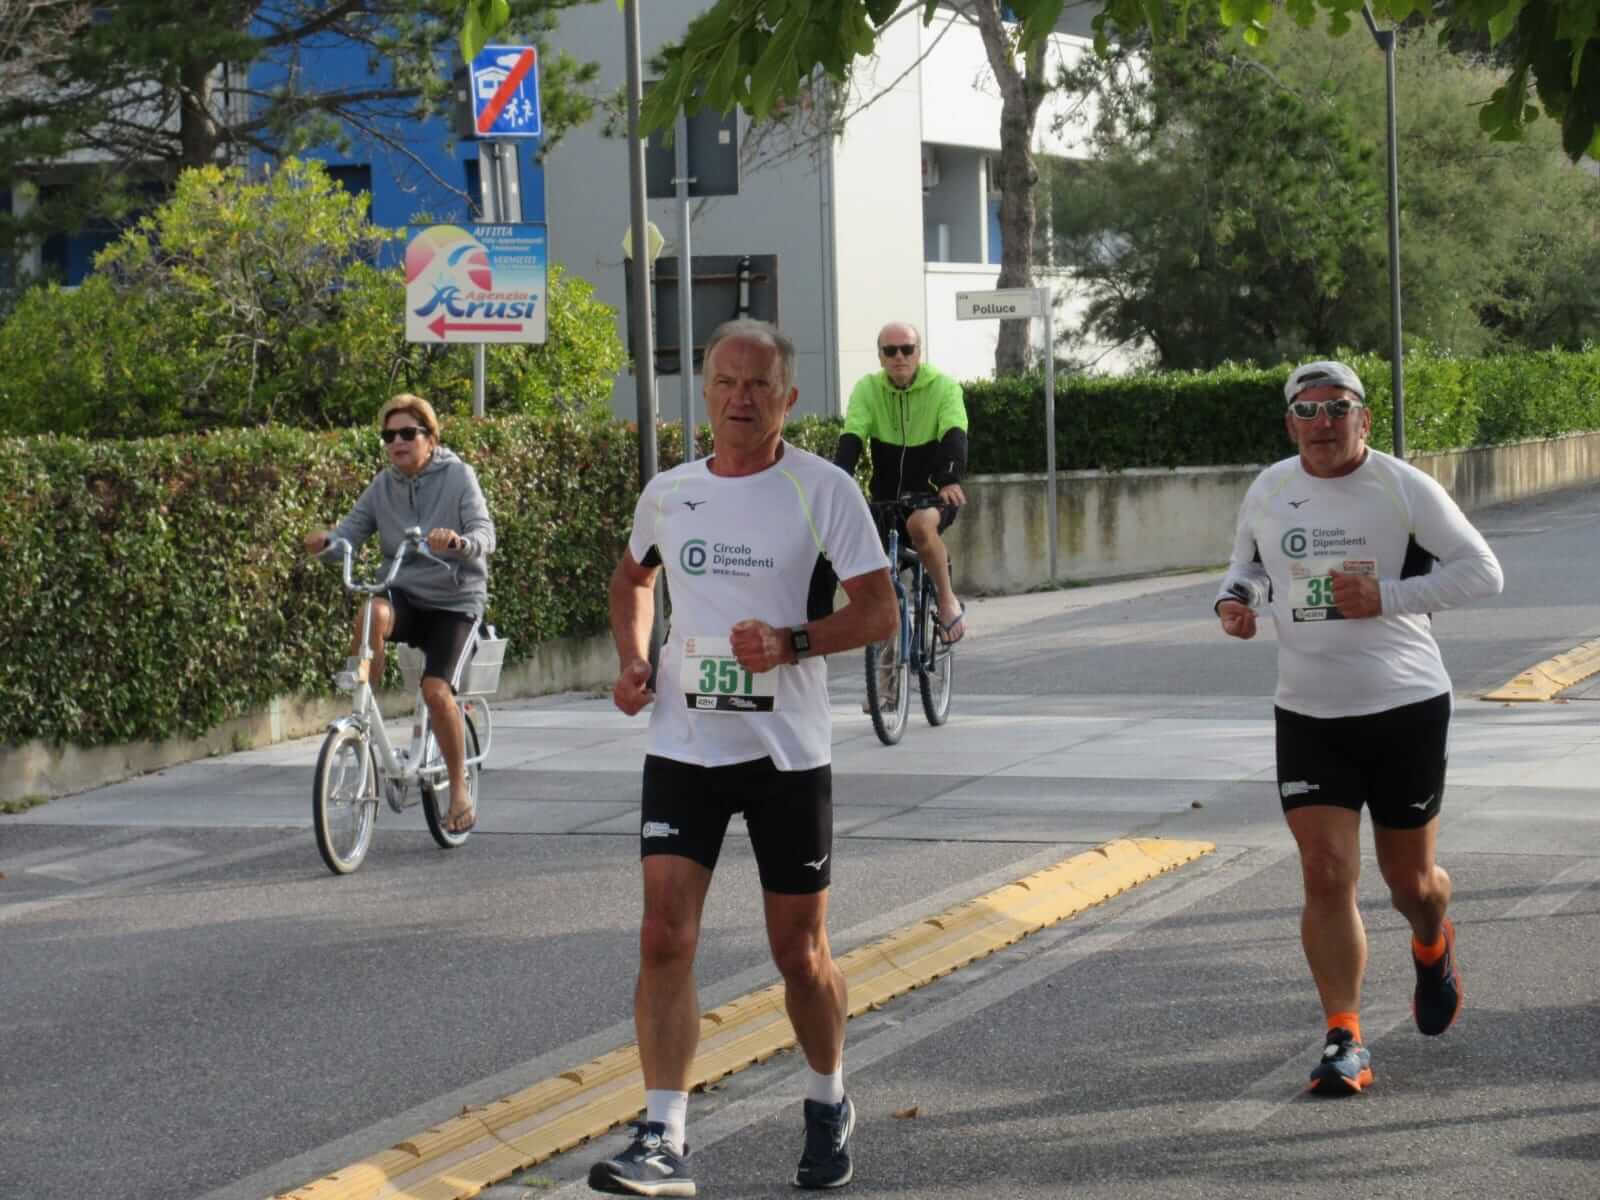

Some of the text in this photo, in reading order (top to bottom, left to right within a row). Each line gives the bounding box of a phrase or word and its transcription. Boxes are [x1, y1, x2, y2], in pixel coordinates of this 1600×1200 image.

[972, 303, 1016, 315] Polluce
[1312, 528, 1345, 537] Circolo
[1312, 536, 1367, 548] Dipendenti
[713, 543, 752, 554] Circolo
[712, 554, 774, 568] Dipendenti
[699, 659, 753, 694] 351
